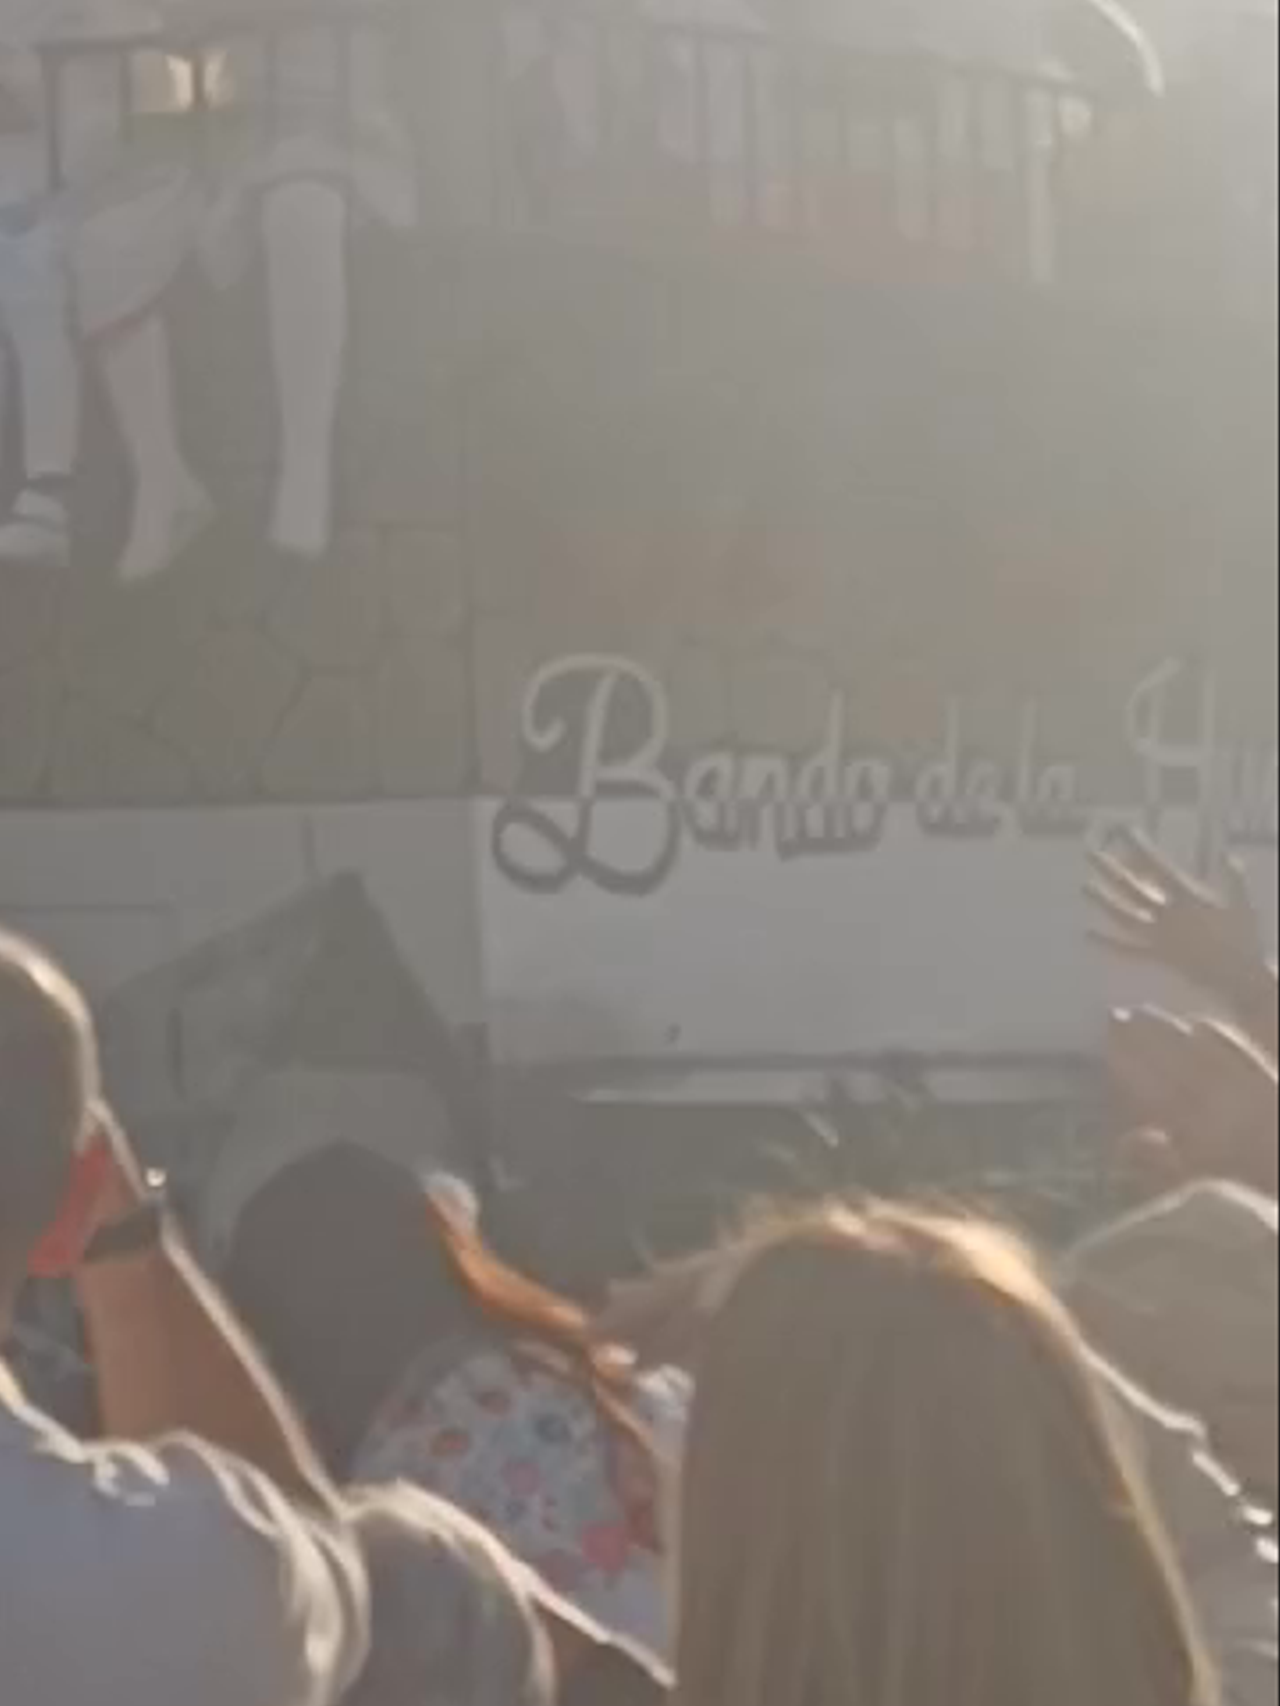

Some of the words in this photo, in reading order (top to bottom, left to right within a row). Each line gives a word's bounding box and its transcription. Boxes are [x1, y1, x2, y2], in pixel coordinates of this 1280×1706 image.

[491, 651, 893, 896] Bando
[914, 694, 996, 837] de
[1014, 696, 1080, 836] la
